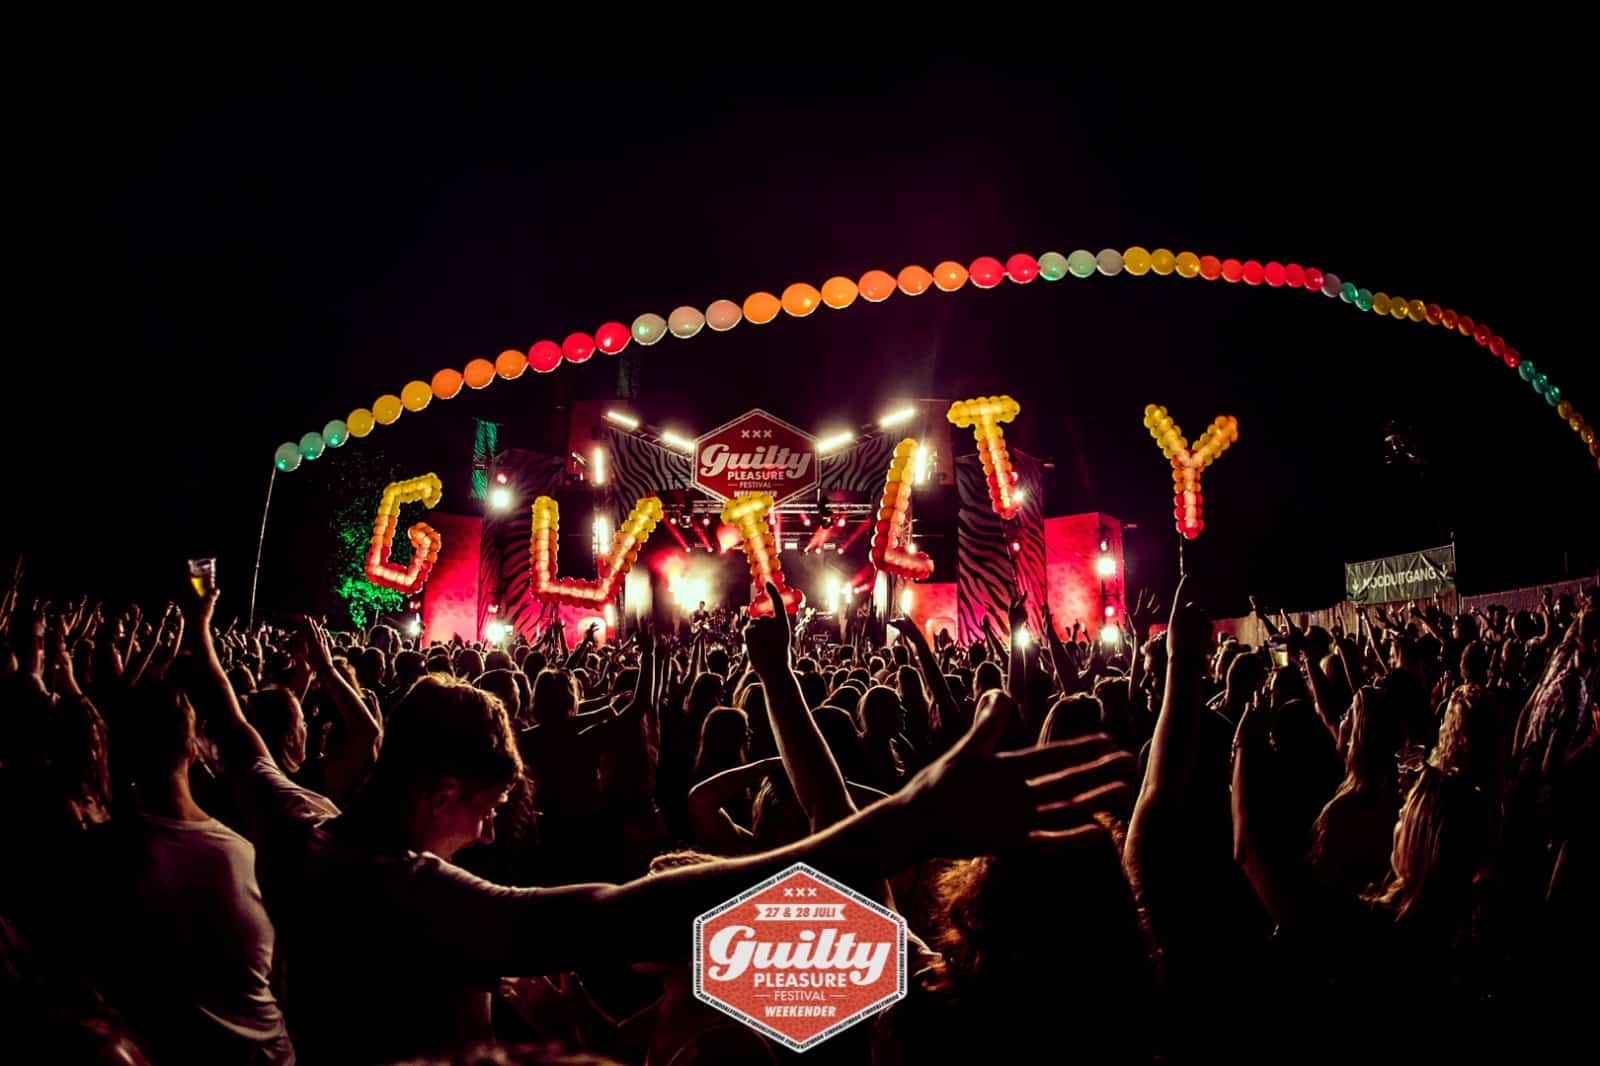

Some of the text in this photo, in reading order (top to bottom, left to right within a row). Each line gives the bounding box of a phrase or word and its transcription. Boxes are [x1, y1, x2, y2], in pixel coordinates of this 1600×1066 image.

[700, 443, 812, 479] Guilty
[728, 471, 784, 480] PLEASURE
[740, 481, 772, 489] FESTIVAL
